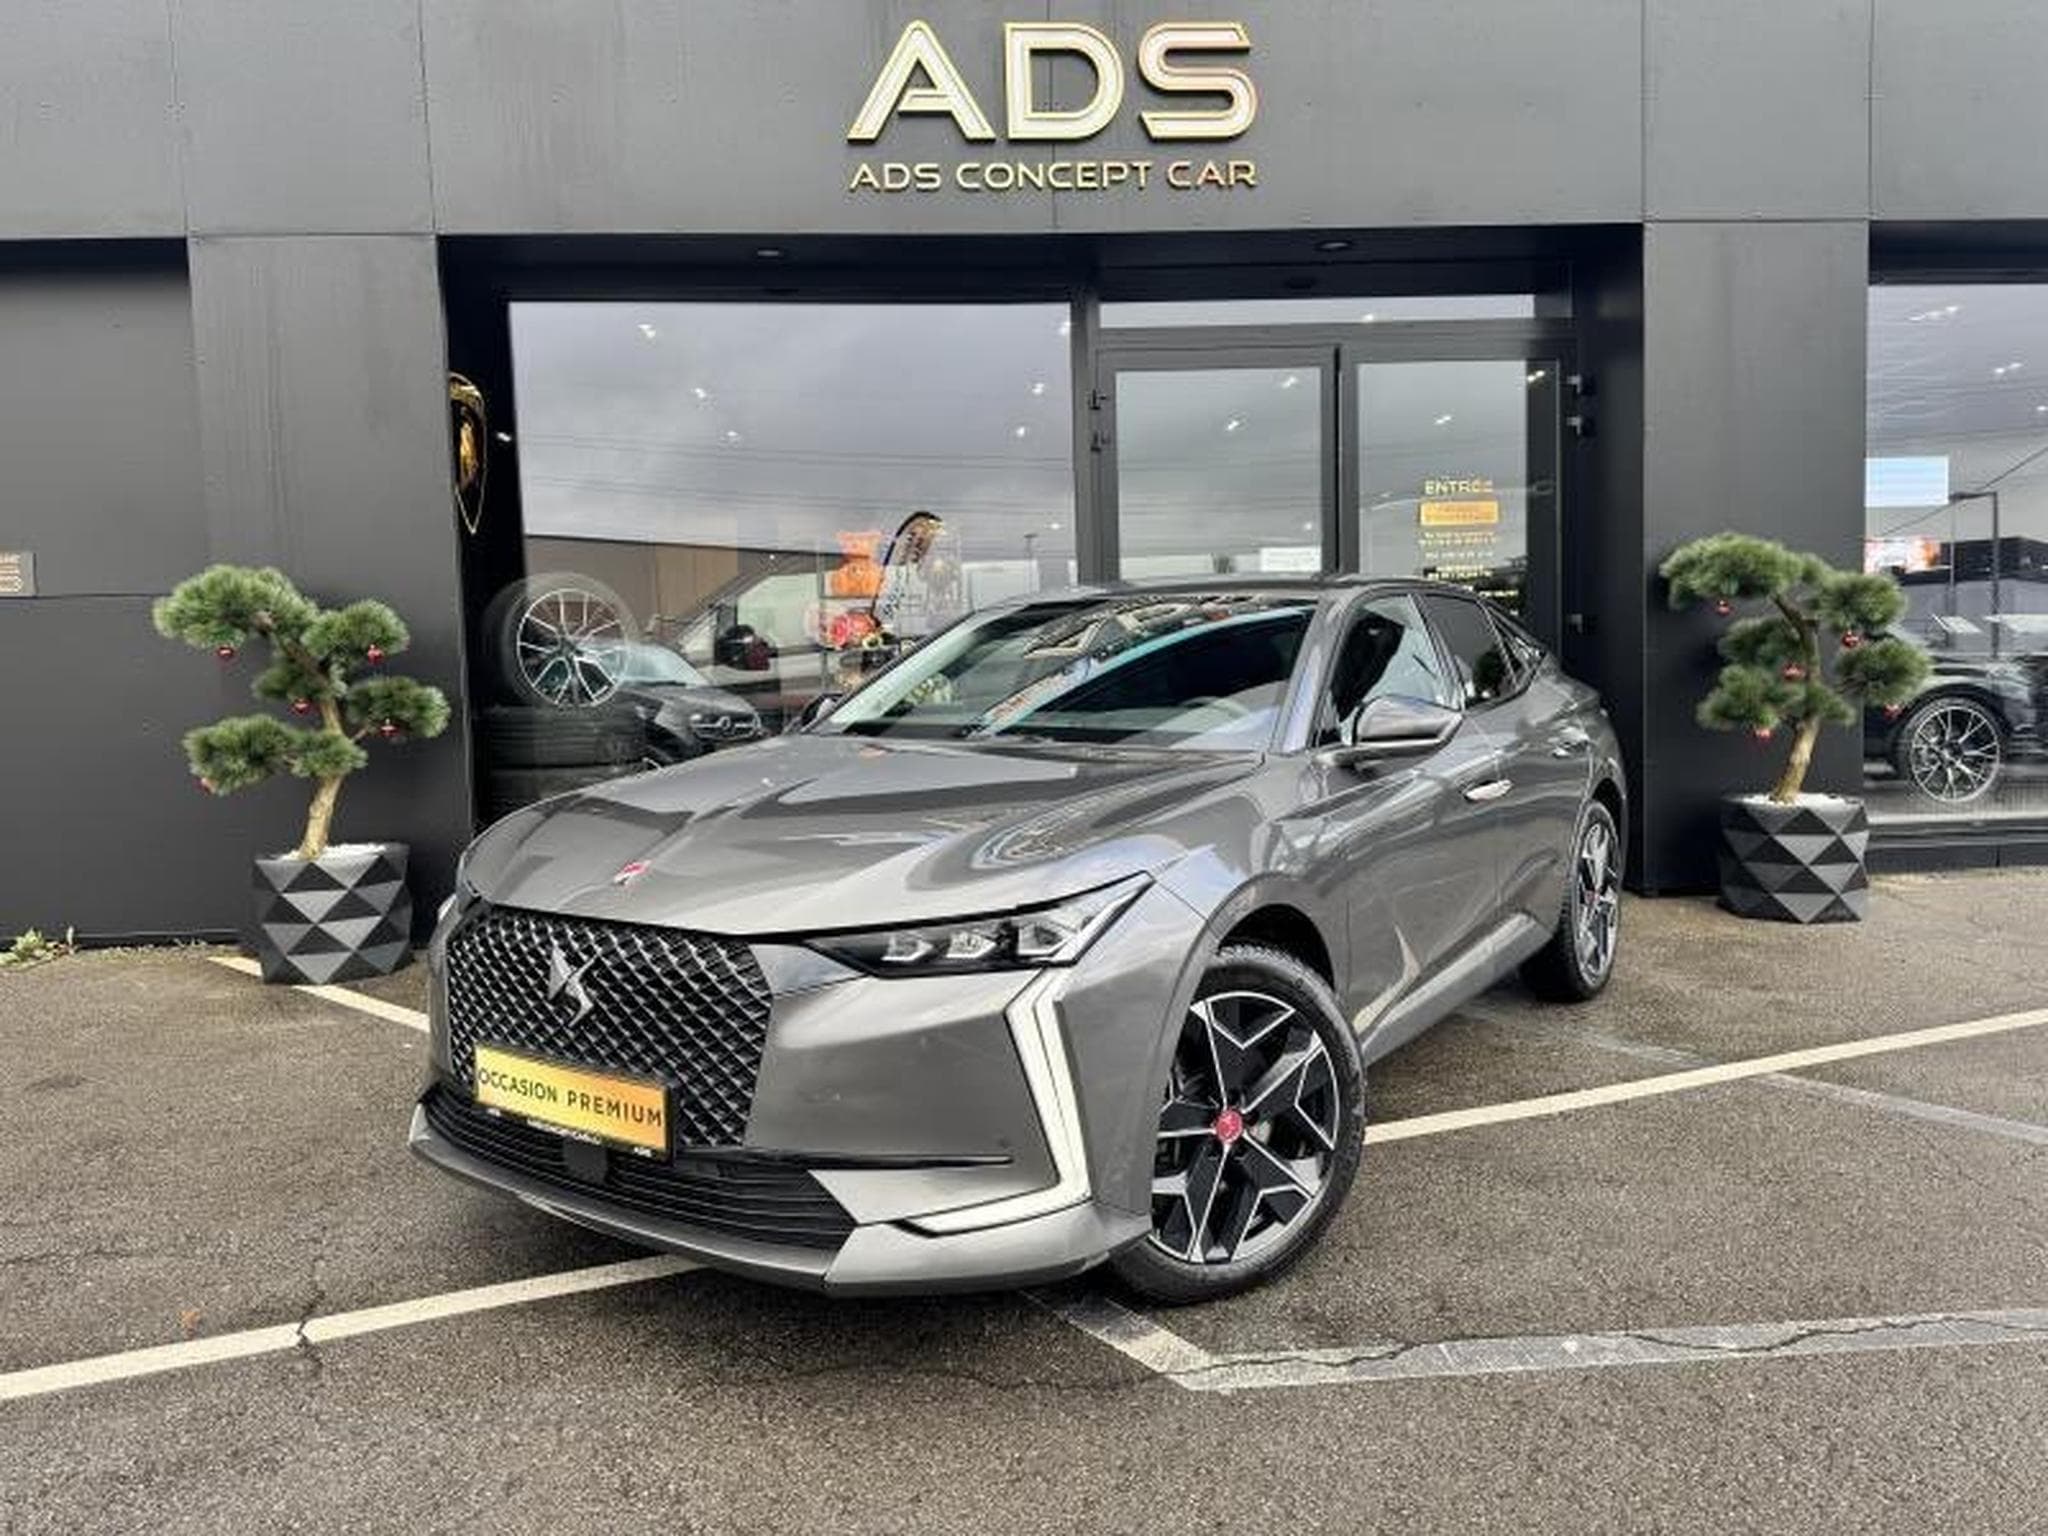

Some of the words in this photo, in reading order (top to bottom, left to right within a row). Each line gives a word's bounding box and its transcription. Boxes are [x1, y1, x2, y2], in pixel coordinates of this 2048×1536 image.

[847, 19, 1258, 143] ADS
[849, 163, 942, 191] ADS
[955, 161, 1153, 191] CONCEPT
[1167, 160, 1258, 190] CAR
[477, 1066, 558, 1104] OCCASION
[567, 1089, 663, 1128] PREMIUM
